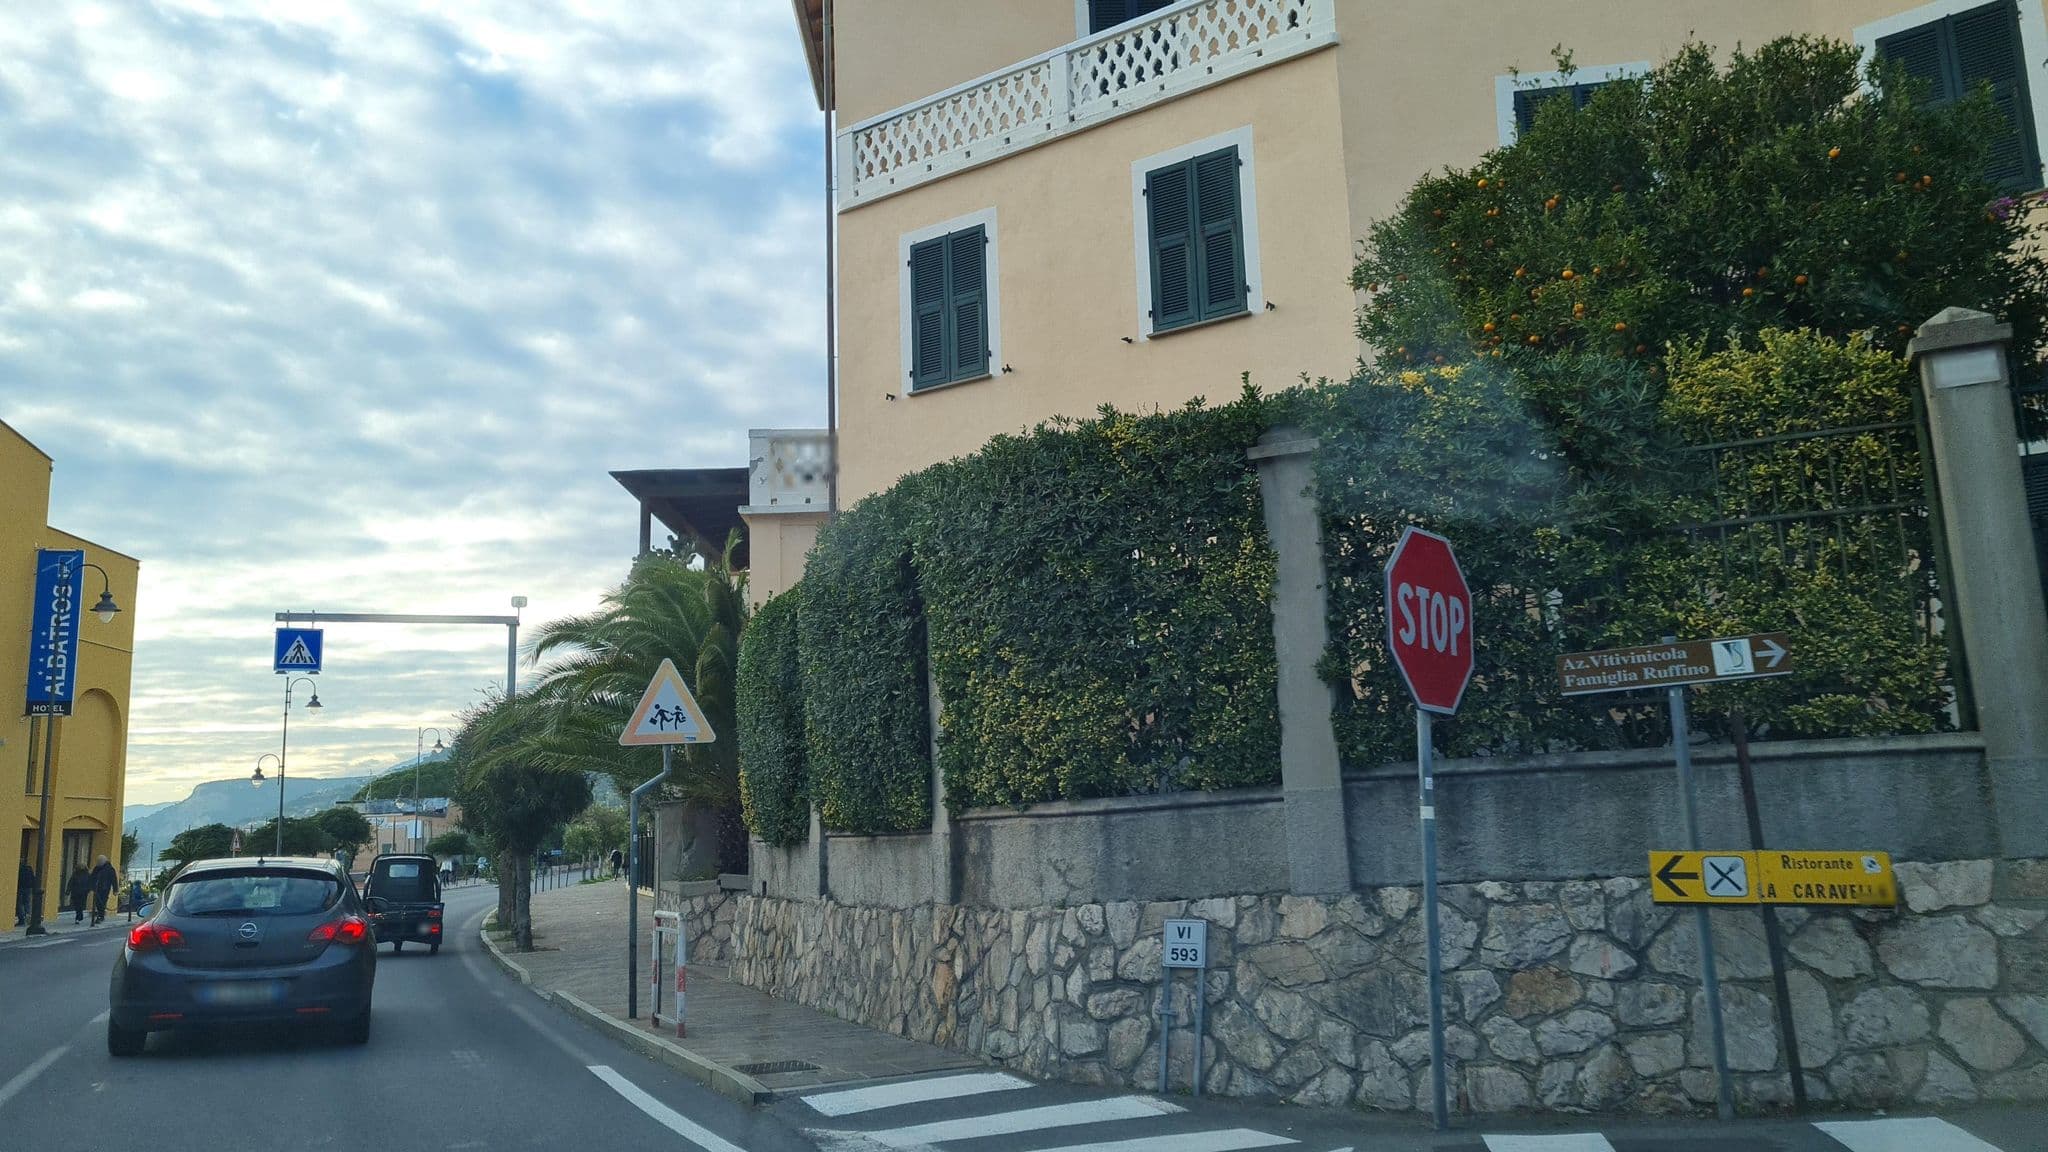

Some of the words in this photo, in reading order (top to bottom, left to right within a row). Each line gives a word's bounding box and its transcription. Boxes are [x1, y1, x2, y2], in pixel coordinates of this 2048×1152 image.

[1397, 582, 1465, 657] STOP
[1565, 669, 1638, 688] Famiglia
[1645, 664, 1710, 680] Ruffino
[1781, 854, 1854, 870] Ristorante
[1759, 883, 1777, 899] A
[1177, 926, 1191, 939] VI
[1170, 948, 1198, 962] 593
